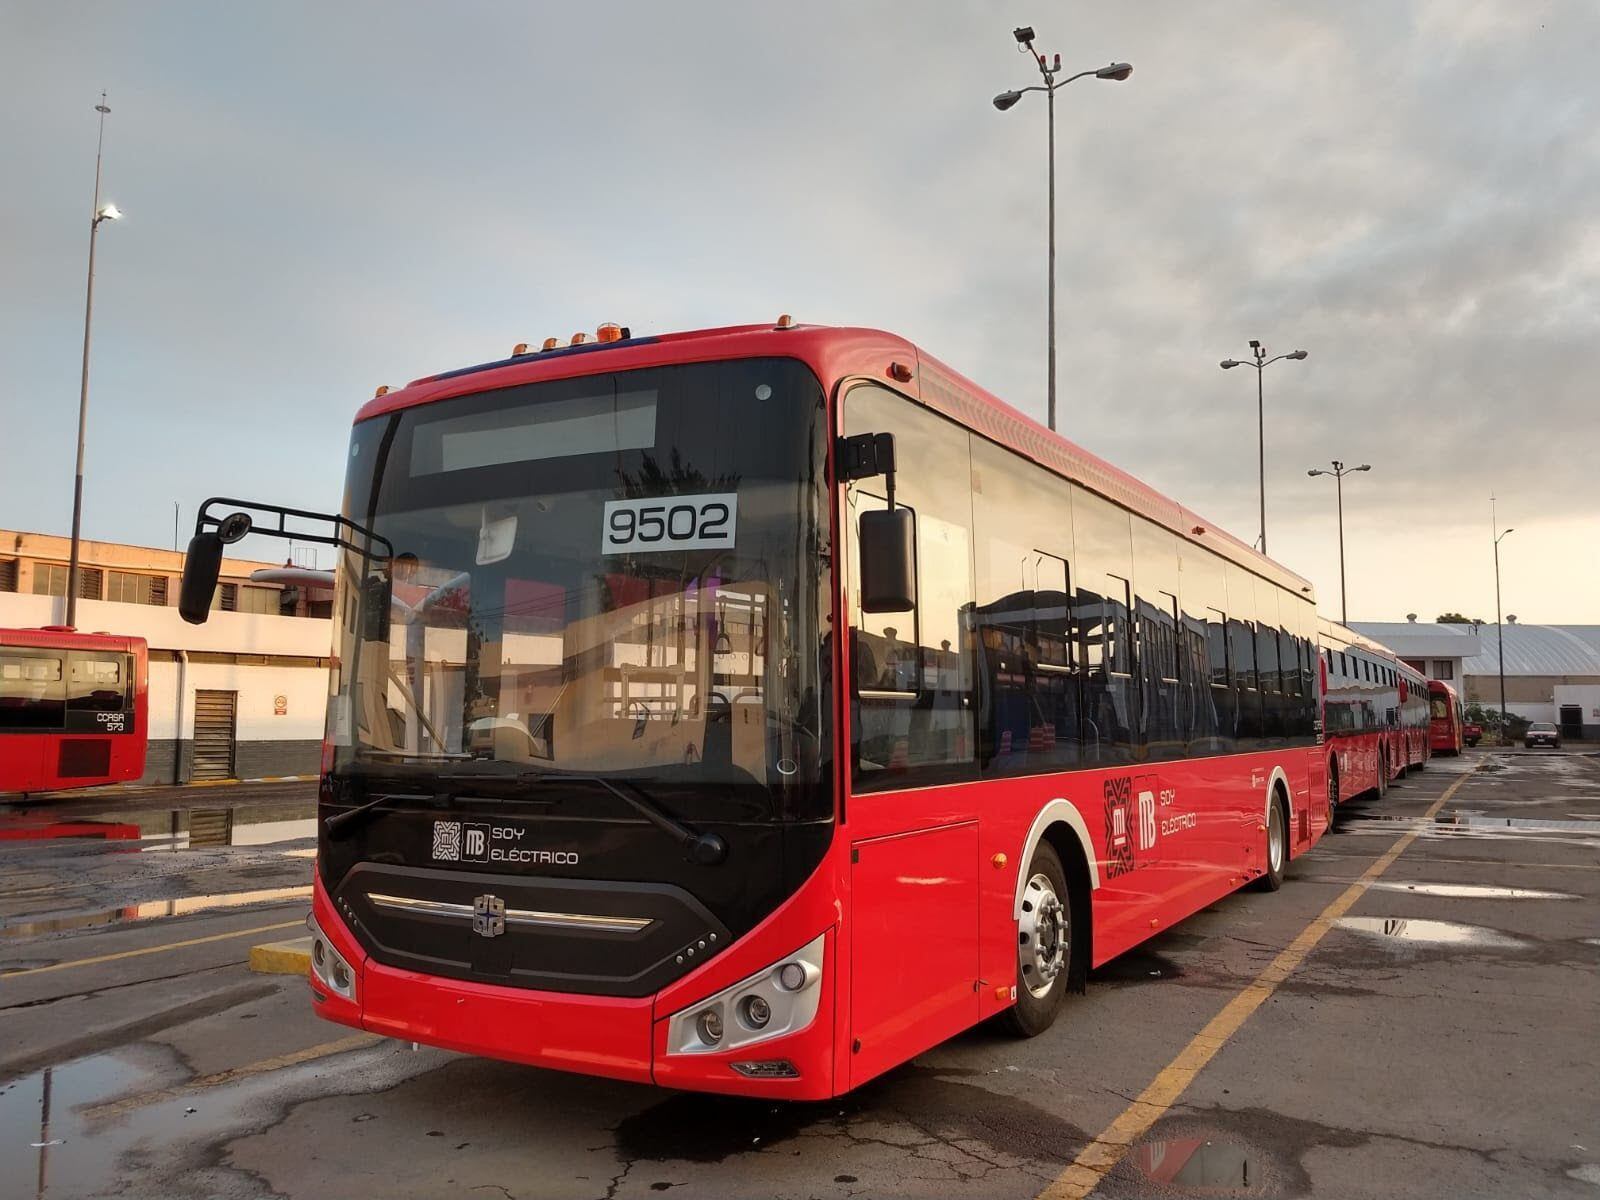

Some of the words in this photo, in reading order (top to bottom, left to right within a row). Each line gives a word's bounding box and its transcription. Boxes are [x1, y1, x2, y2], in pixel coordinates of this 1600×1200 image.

[609, 503, 729, 544] 9502
[106, 722, 124, 731] 573
[1160, 789, 1175, 806] SOY
[492, 827, 525, 840] SOY
[490, 847, 579, 865] ELÉCTRICO
